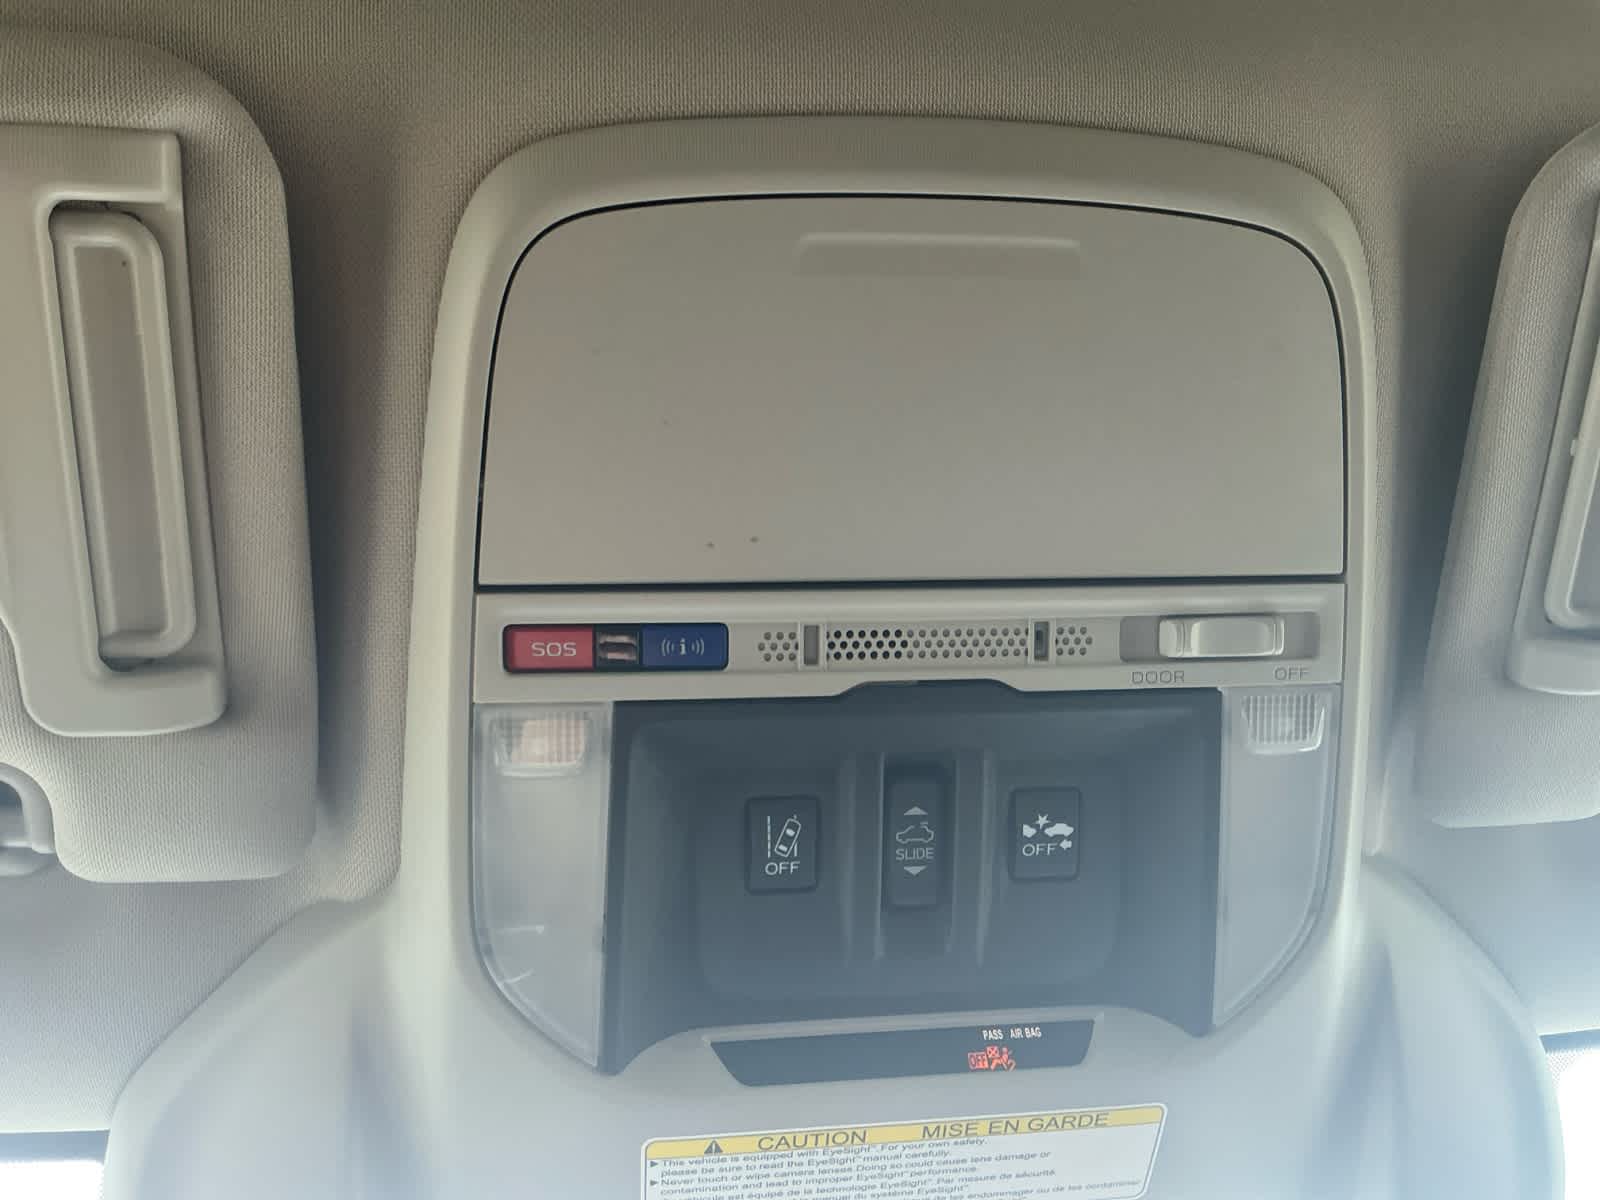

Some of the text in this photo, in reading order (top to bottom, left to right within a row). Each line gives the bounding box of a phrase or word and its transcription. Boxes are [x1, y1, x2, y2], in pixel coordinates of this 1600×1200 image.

[531, 641, 577, 657] SOS
[1131, 670, 1185, 684] DOOR
[1274, 667, 1309, 681] OFF
[895, 847, 935, 860] SLIDE
[1022, 843, 1058, 856] OFF
[764, 861, 801, 876] OFF
[982, 1026, 1042, 1040] PASS AIR BAG
[758, 1112, 1110, 1151] CAUTION MISE EN GARDE
[688, 1156, 728, 1166] vehicle
[743, 1151, 793, 1162] equipped
[797, 1150, 819, 1158] with
[902, 1143, 925, 1151] your
[953, 1138, 988, 1147] safety.
[661, 1168, 698, 1177] please
[760, 1161, 784, 1170] read
[787, 1159, 804, 1167] the
[863, 1152, 902, 1162] manual
[698, 1174, 728, 1183] touch
[745, 1173, 770, 1182] wipe
[774, 1169, 815, 1178] camera
[856, 1163, 888, 1173] Doing
[905, 1160, 934, 1168] could
[936, 1158, 968, 1166] cause
[970, 1155, 993, 1163] lens
[995, 1152, 1038, 1161] damage
[661, 1183, 739, 1196] contamination
[766, 1179, 789, 1188] lead
[792, 1178, 802, 1186] to
[805, 1175, 853, 1186] improper
